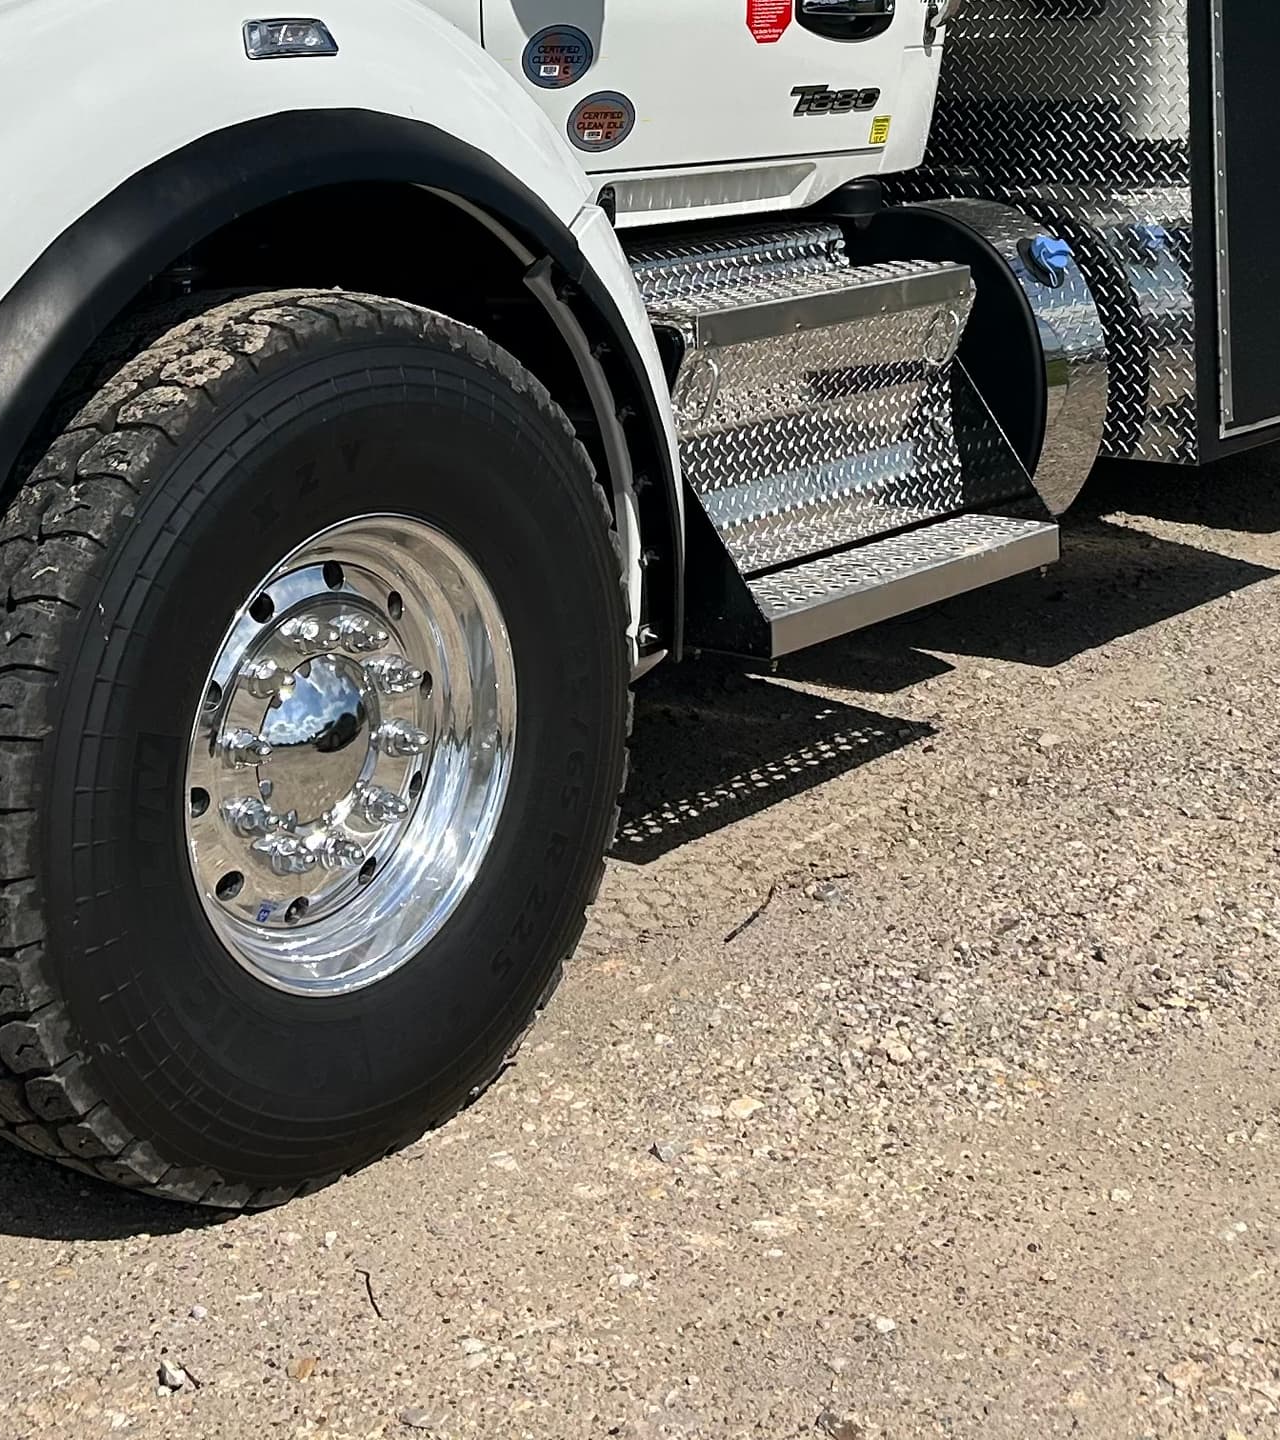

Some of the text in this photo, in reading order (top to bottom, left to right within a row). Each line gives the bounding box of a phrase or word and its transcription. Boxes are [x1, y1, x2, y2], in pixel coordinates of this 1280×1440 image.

[538, 45, 580, 54] CERTIFIED
[532, 56, 583, 64] CLEAN IDLE
[790, 84, 881, 117] T880
[582, 112, 624, 120] CERTIFIED
[576, 121, 625, 130] CLEAN IDLE
